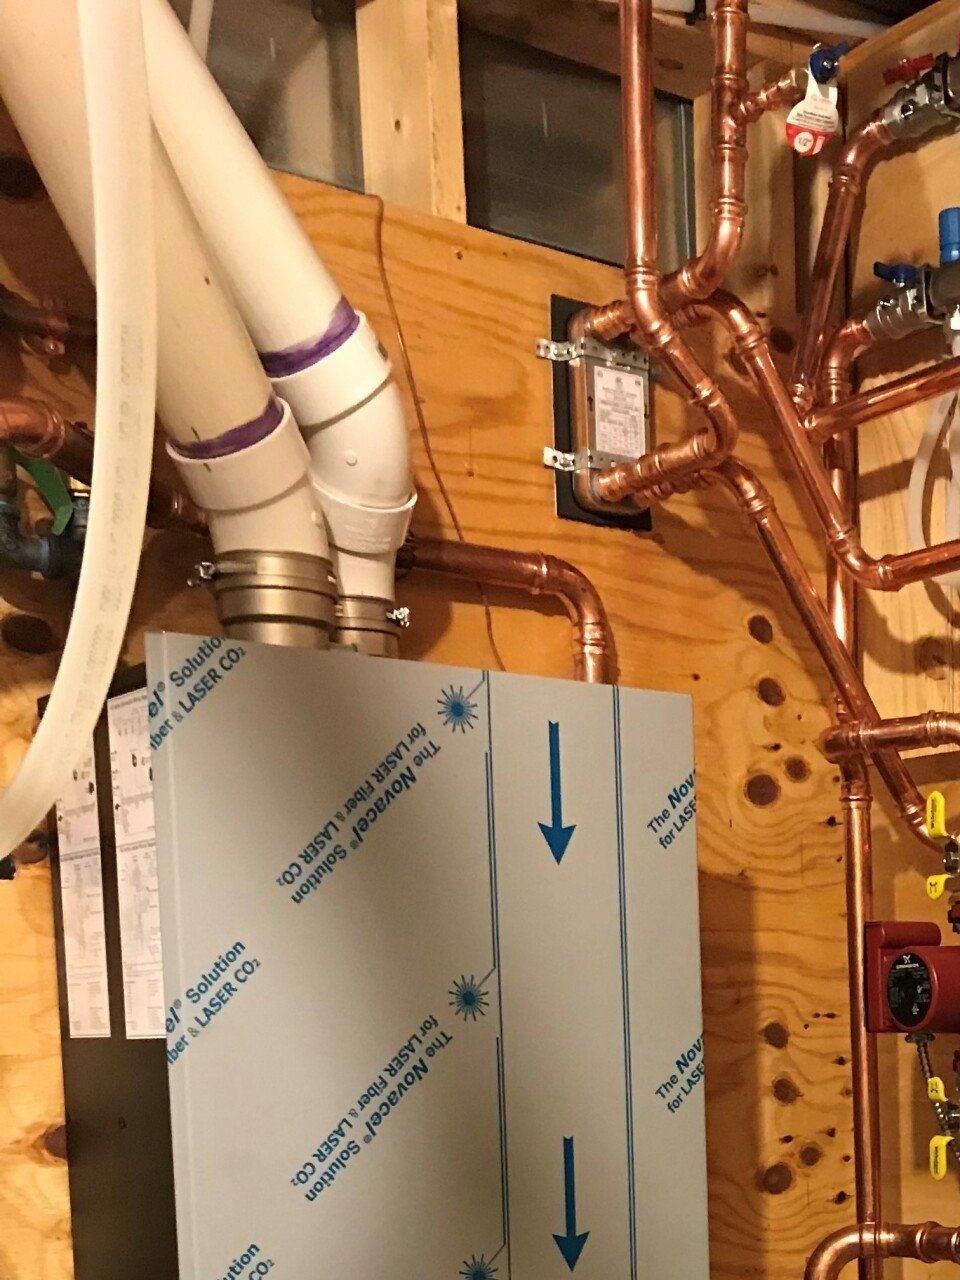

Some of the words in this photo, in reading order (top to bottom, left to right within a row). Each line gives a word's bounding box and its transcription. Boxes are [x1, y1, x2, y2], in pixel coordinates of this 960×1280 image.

[169, 636, 224, 687] Solutio
[171, 711, 184, 722] &
[178, 668, 222, 713] LASER
[407, 723, 427, 744] for
[413, 740, 441, 767] The
[372, 740, 410, 783] LASER
[344, 780, 375, 815] Fiber
[647, 809, 670, 833] The
[667, 768, 696, 809] Nov
[298, 820, 340, 865] LASER
[659, 829, 675, 850] for
[291, 844, 347, 904] Solution
[185, 941, 246, 1003] Solution
[187, 1027, 200, 1038] &
[194, 982, 237, 1028] LASER
[420, 1015, 439, 1036] for
[384, 1034, 423, 1077] LASER
[425, 1031, 453, 1058] The
[357, 1075, 389, 1111] Fiber
[655, 1074, 678, 1099] The
[667, 1093, 683, 1113] for
[312, 1118, 353, 1163] LASER
[304, 1140, 361, 1201] Solution
